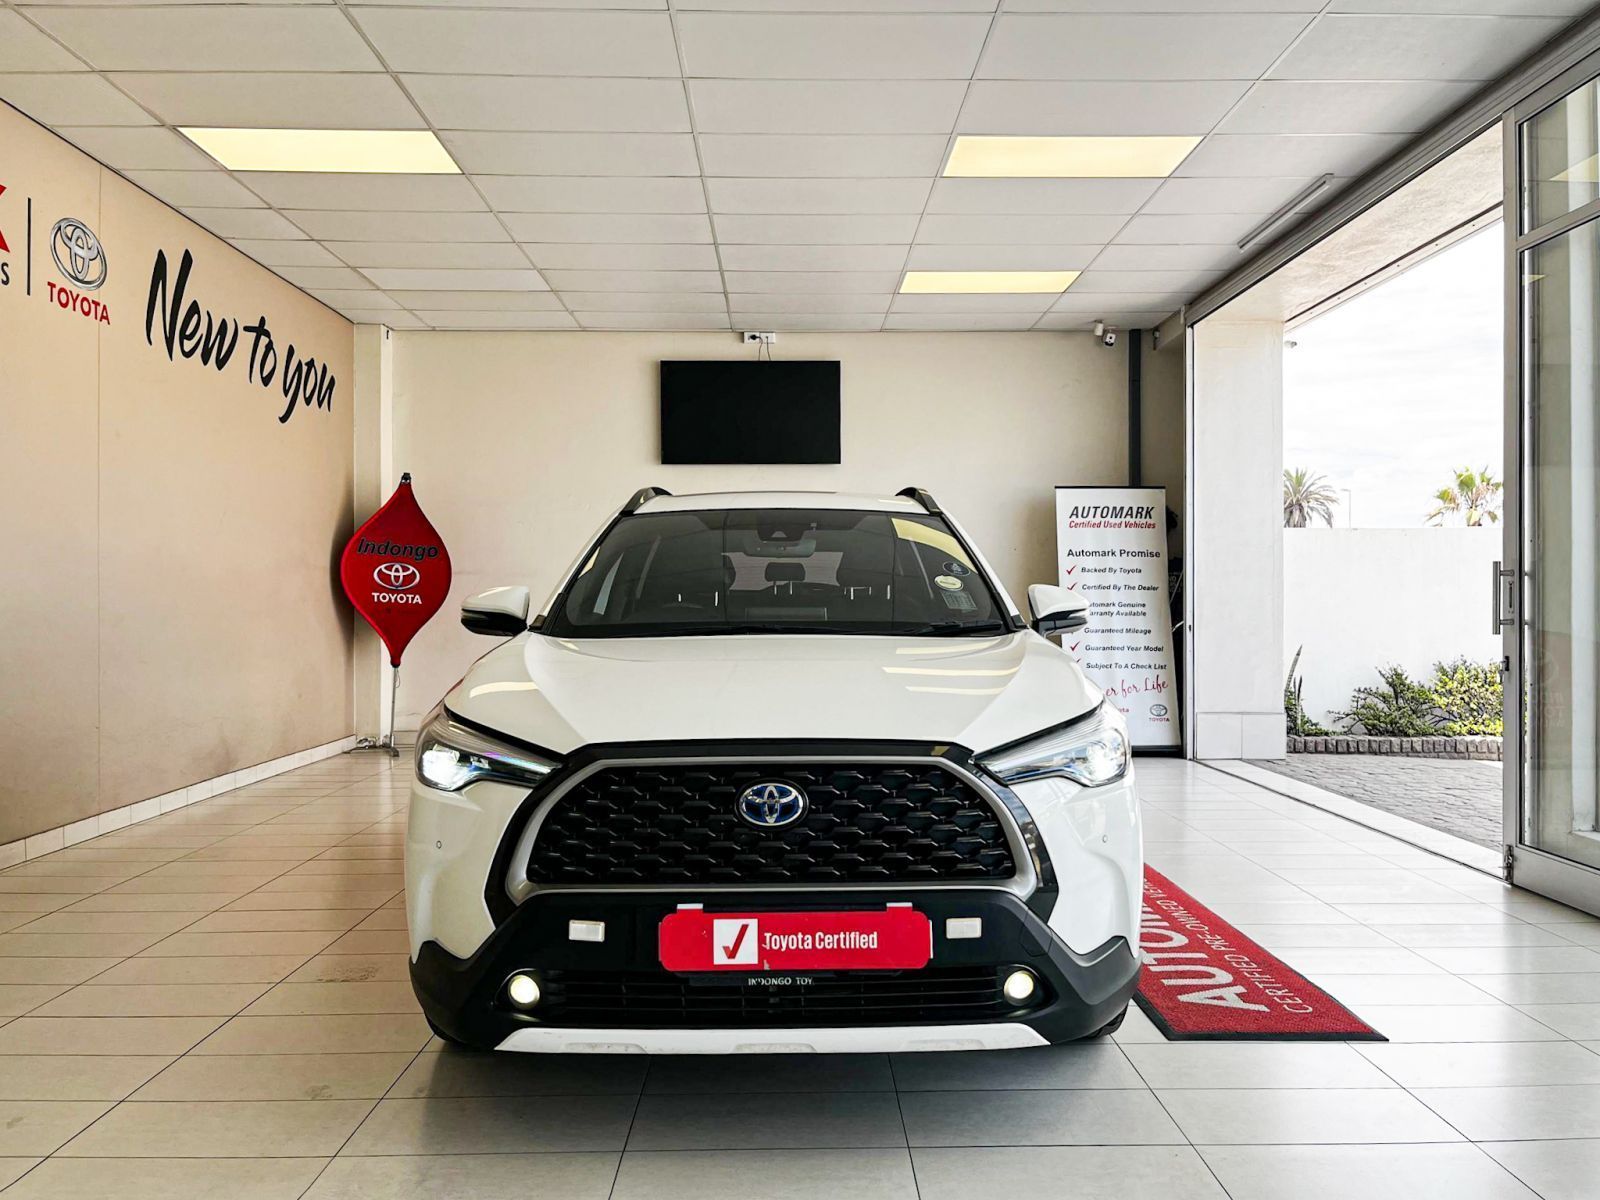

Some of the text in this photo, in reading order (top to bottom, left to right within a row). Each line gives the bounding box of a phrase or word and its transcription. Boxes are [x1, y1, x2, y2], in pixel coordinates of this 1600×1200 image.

[47, 281, 111, 326] TOYOTA
[145, 248, 336, 424] New to you
[1069, 506, 1155, 519] AUTOMARK
[1069, 520, 1157, 529] Certified Used Vehicles
[357, 538, 440, 562] Indongo
[1067, 548, 1161, 558] Automark Promise
[1108, 567, 1117, 575] By
[1119, 567, 1142, 575] Toyota
[1112, 584, 1122, 592] By
[1137, 584, 1160, 592] Dealer
[372, 592, 422, 605] TOYOTA
[1125, 628, 1152, 636] Mileage
[1121, 680, 1140, 698] for
[1144, 674, 1169, 693] Life
[763, 932, 878, 951] Toyota Certified
[1156, 898, 1314, 1014] CERTIFIED PRE-OWNED
